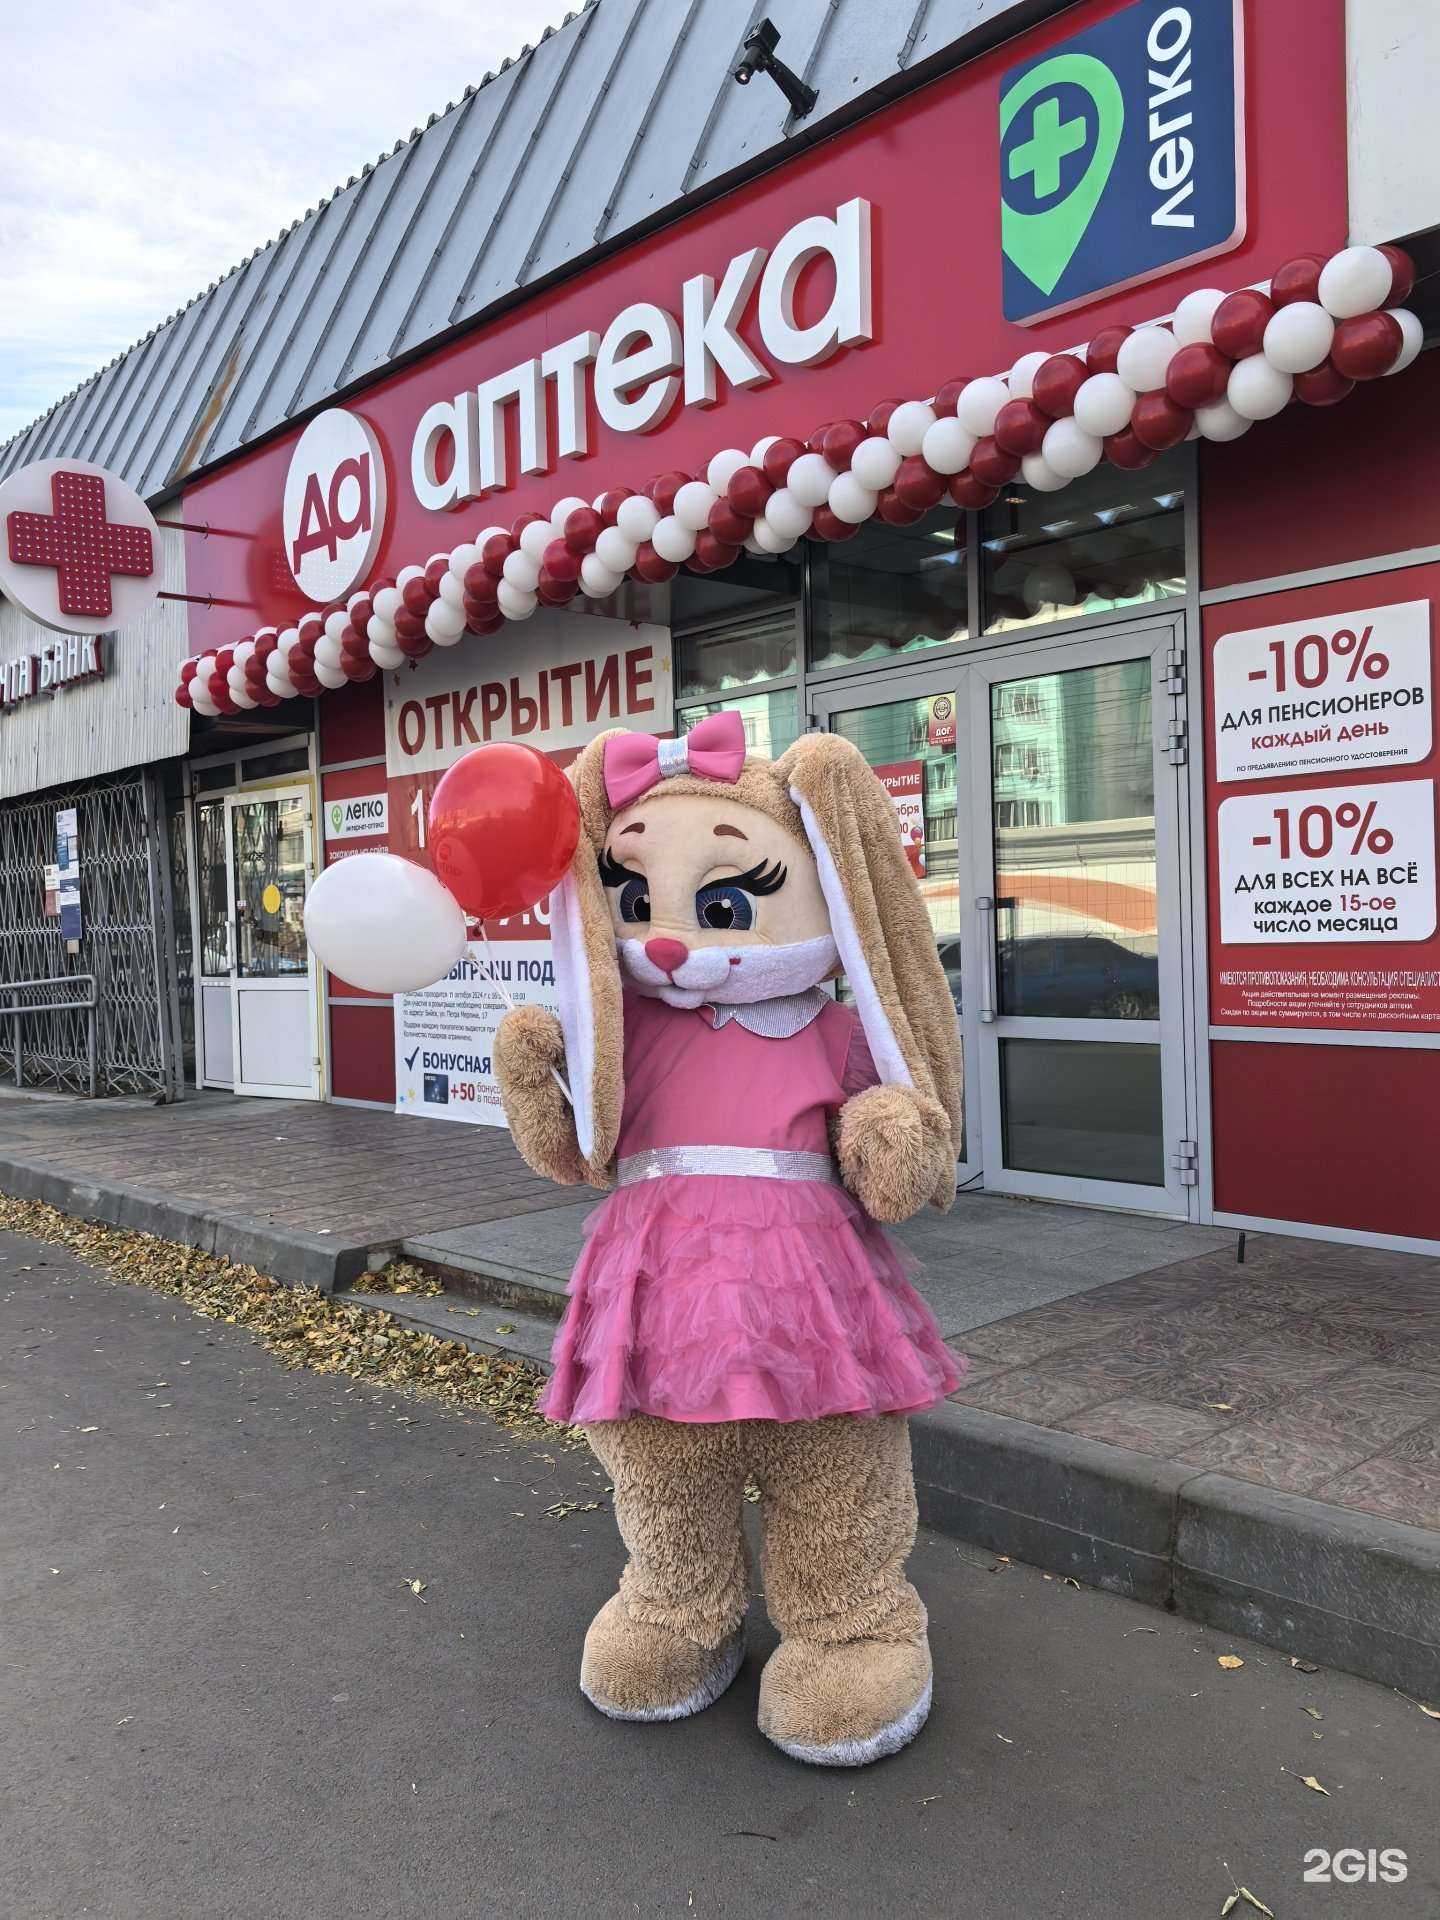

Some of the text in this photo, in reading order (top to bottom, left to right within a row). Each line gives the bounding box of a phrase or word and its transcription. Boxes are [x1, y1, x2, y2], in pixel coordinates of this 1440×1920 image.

[411, 197, 872, 511] аптека
[40, 633, 97, 689] БАНК
[1248, 625, 1390, 692] -10%
[398, 646, 654, 755] ОТКРЫТИЕ
[1221, 687, 1424, 732] ДЛЯ ПЕНСИОНЕРОВ
[1251, 721, 1389, 749] каждый день
[1247, 760, 1298, 772] ПРЕДЪЯВЛЕНИЮ
[1299, 754, 1350, 765] ПЕНСИОННОГО
[1351, 748, 1408, 760] УДОСТОВЕРЕНИЯ
[346, 800, 383, 821] легко
[1252, 801, 1394, 859] -10%
[1234, 862, 1418, 893] ДЛЯ ВСЕХ НА ВСЁ
[1254, 894, 1396, 915] каждое 15-ое
[1254, 917, 1398, 933] число месяца
[423, 1052, 491, 1074] БОНУСНАЯ
[451, 1082, 475, 1102] +50
